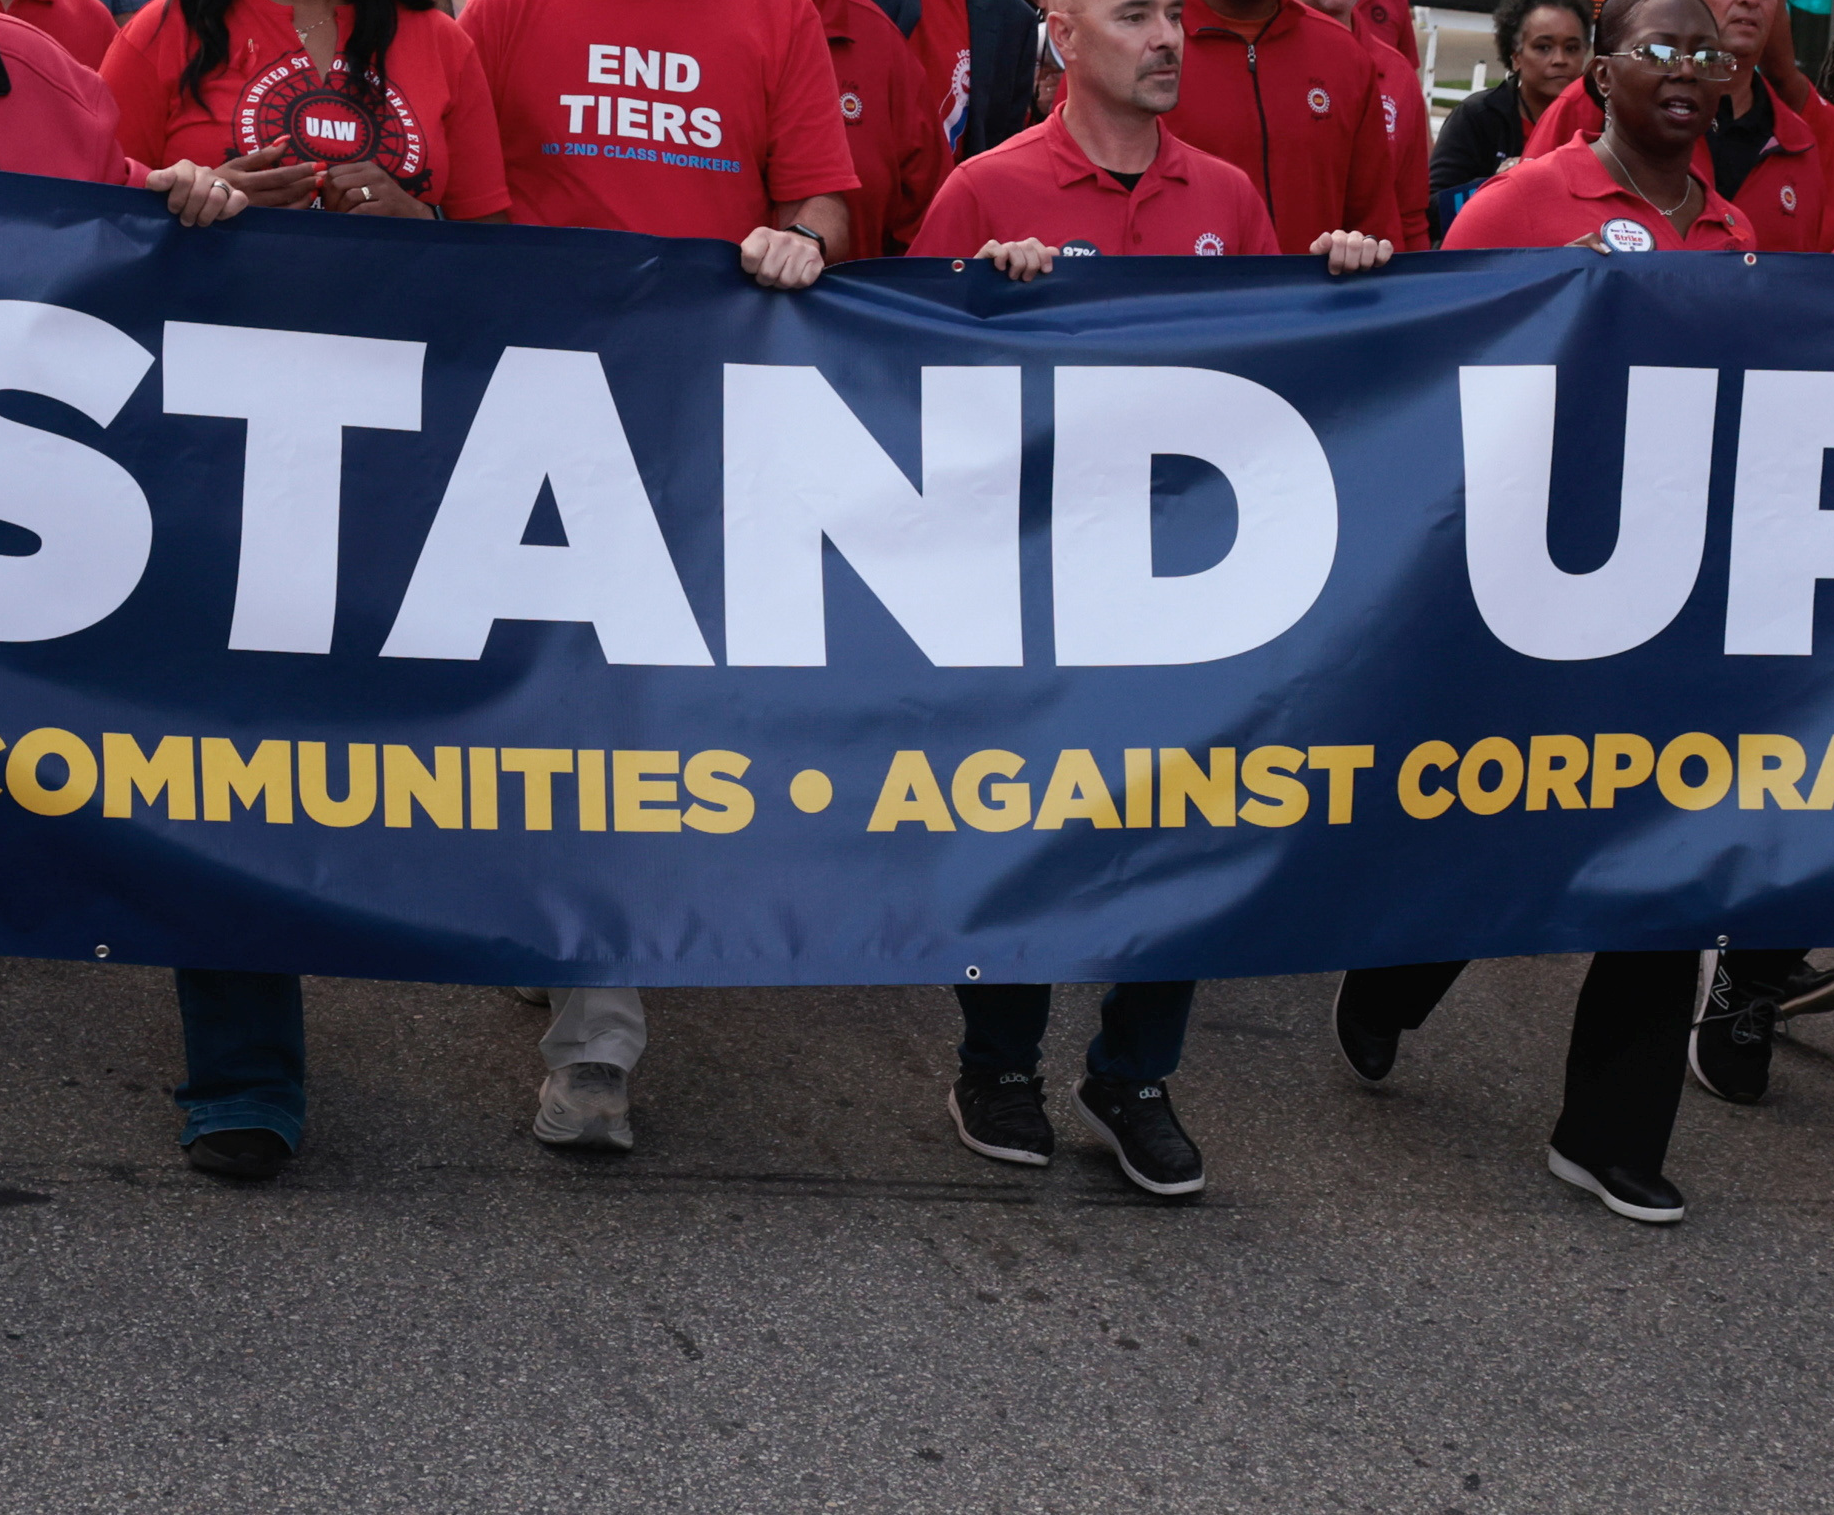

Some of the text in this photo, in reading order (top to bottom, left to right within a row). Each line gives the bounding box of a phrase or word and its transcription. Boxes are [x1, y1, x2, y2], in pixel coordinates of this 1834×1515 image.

[588, 43, 700, 93] END
[242, 66, 420, 174] LABOR UNITED THAN EVER
[306, 116, 356, 142] UAW
[560, 94, 722, 148] TIERS
[541, 143, 741, 173] NO 2ND CLASS WORKERS
[866, 744, 1374, 832] AGAINST
